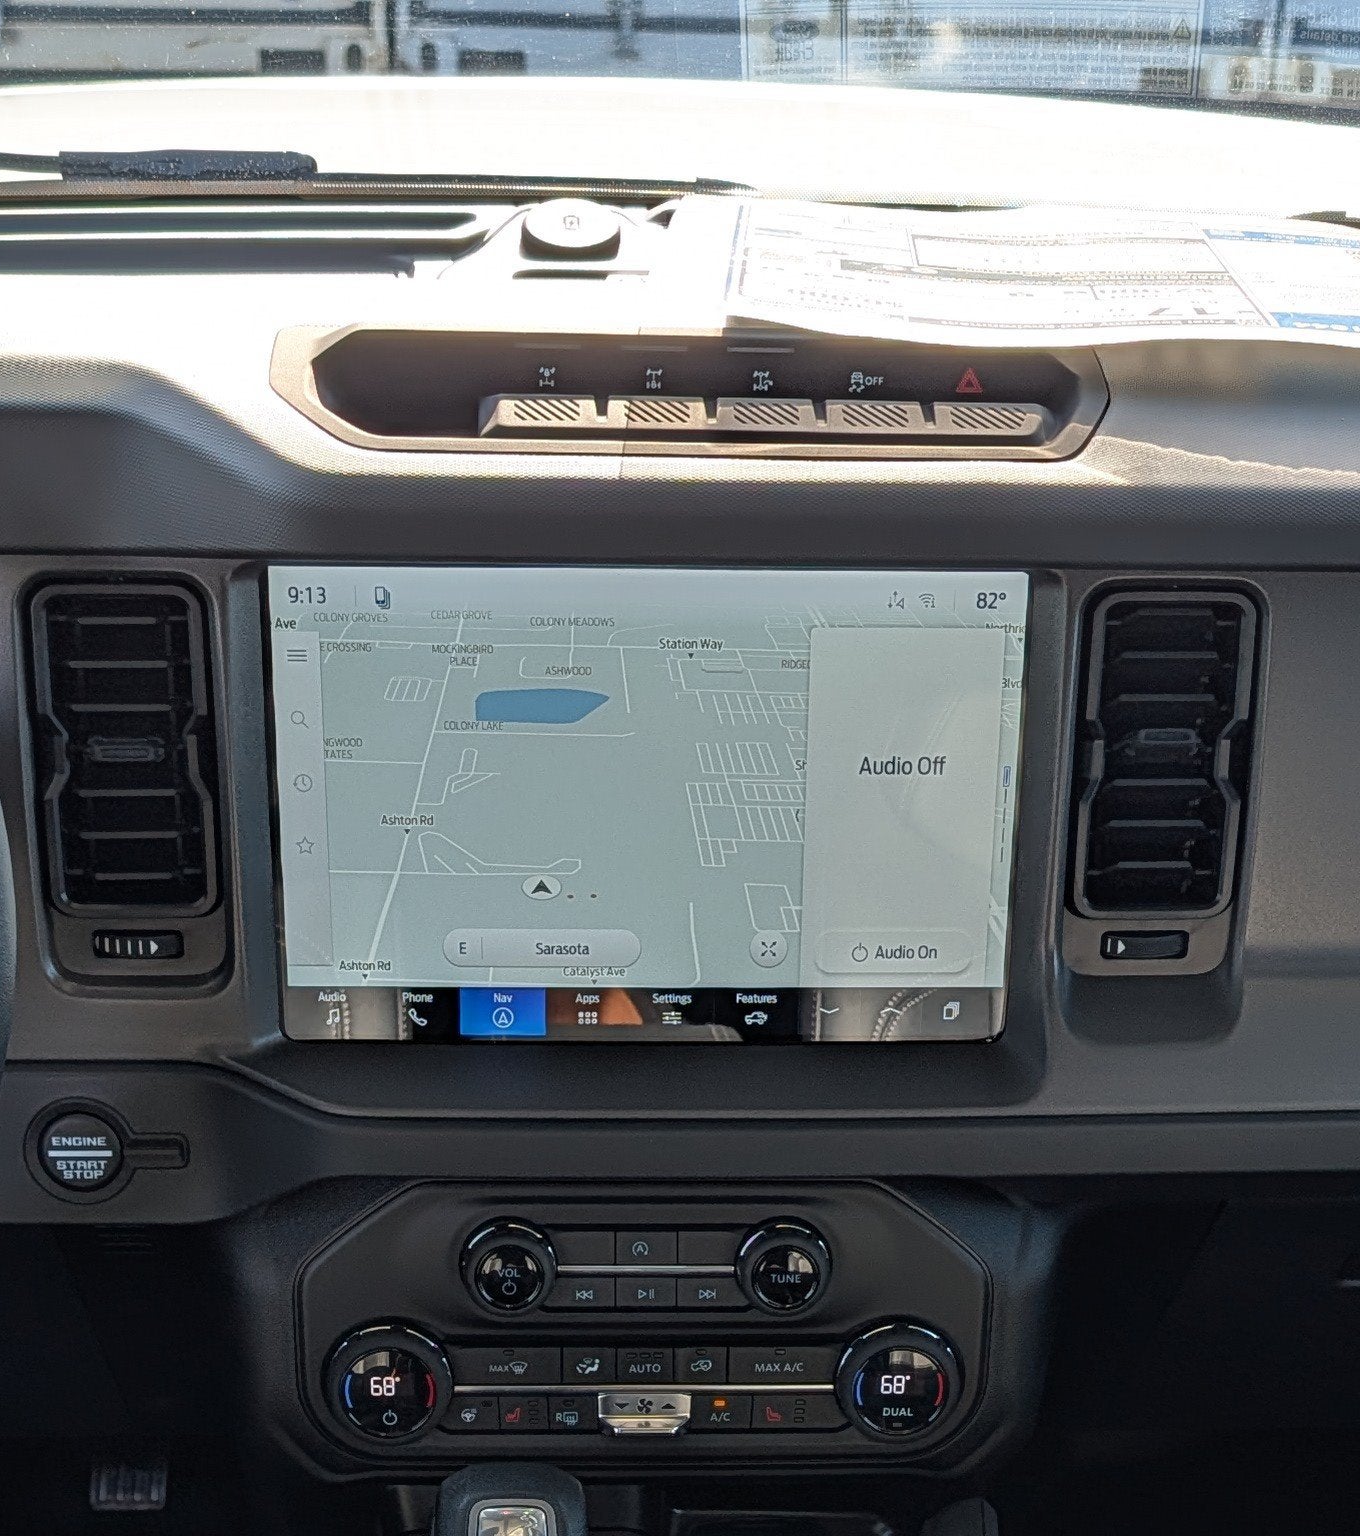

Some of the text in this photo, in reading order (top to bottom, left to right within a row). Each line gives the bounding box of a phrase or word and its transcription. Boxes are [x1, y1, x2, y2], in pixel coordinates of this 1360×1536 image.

[865, 376, 885, 387] OFF
[288, 586, 326, 604] 9:13
[976, 592, 1007, 610] 82°
[313, 612, 388, 623] COLONY GROVES
[431, 610, 493, 620] CEDAR GROVE
[275, 617, 297, 630] Ave
[530, 616, 615, 627] COLONY MEADOWS
[327, 642, 372, 653] CROSSING
[431, 644, 494, 654] MOCKINGBIRD
[659, 638, 723, 651] Station Way
[449, 656, 477, 666] PLACE
[545, 666, 592, 676] ASHWOOD
[443, 721, 504, 731] COLONY LAKE
[859, 756, 946, 775] Audio Off
[381, 815, 434, 827] Ashton Rd
[459, 942, 590, 955] E Sarasota
[875, 946, 937, 961] Audio On
[340, 960, 391, 971] Ashton Rd
[563, 966, 625, 978] Catalyst Ave
[318, 993, 346, 1002] Audio
[402, 993, 433, 1003] Phone
[493, 993, 513, 1002] Nav
[575, 993, 600, 1005] Apps
[652, 993, 692, 1005] Settings
[736, 993, 778, 1004] Features
[51, 1137, 107, 1146] ENGINE
[56, 1160, 107, 1170] START
[63, 1170, 104, 1180] STOP
[497, 1268, 521, 1278] VOL
[770, 1274, 802, 1284] TUNE
[489, 1364, 509, 1373] MAX
[628, 1364, 661, 1374] AUTO
[755, 1363, 804, 1373] MAX A/C
[710, 1413, 731, 1423] A/C
[882, 1407, 914, 1418] DUAL
